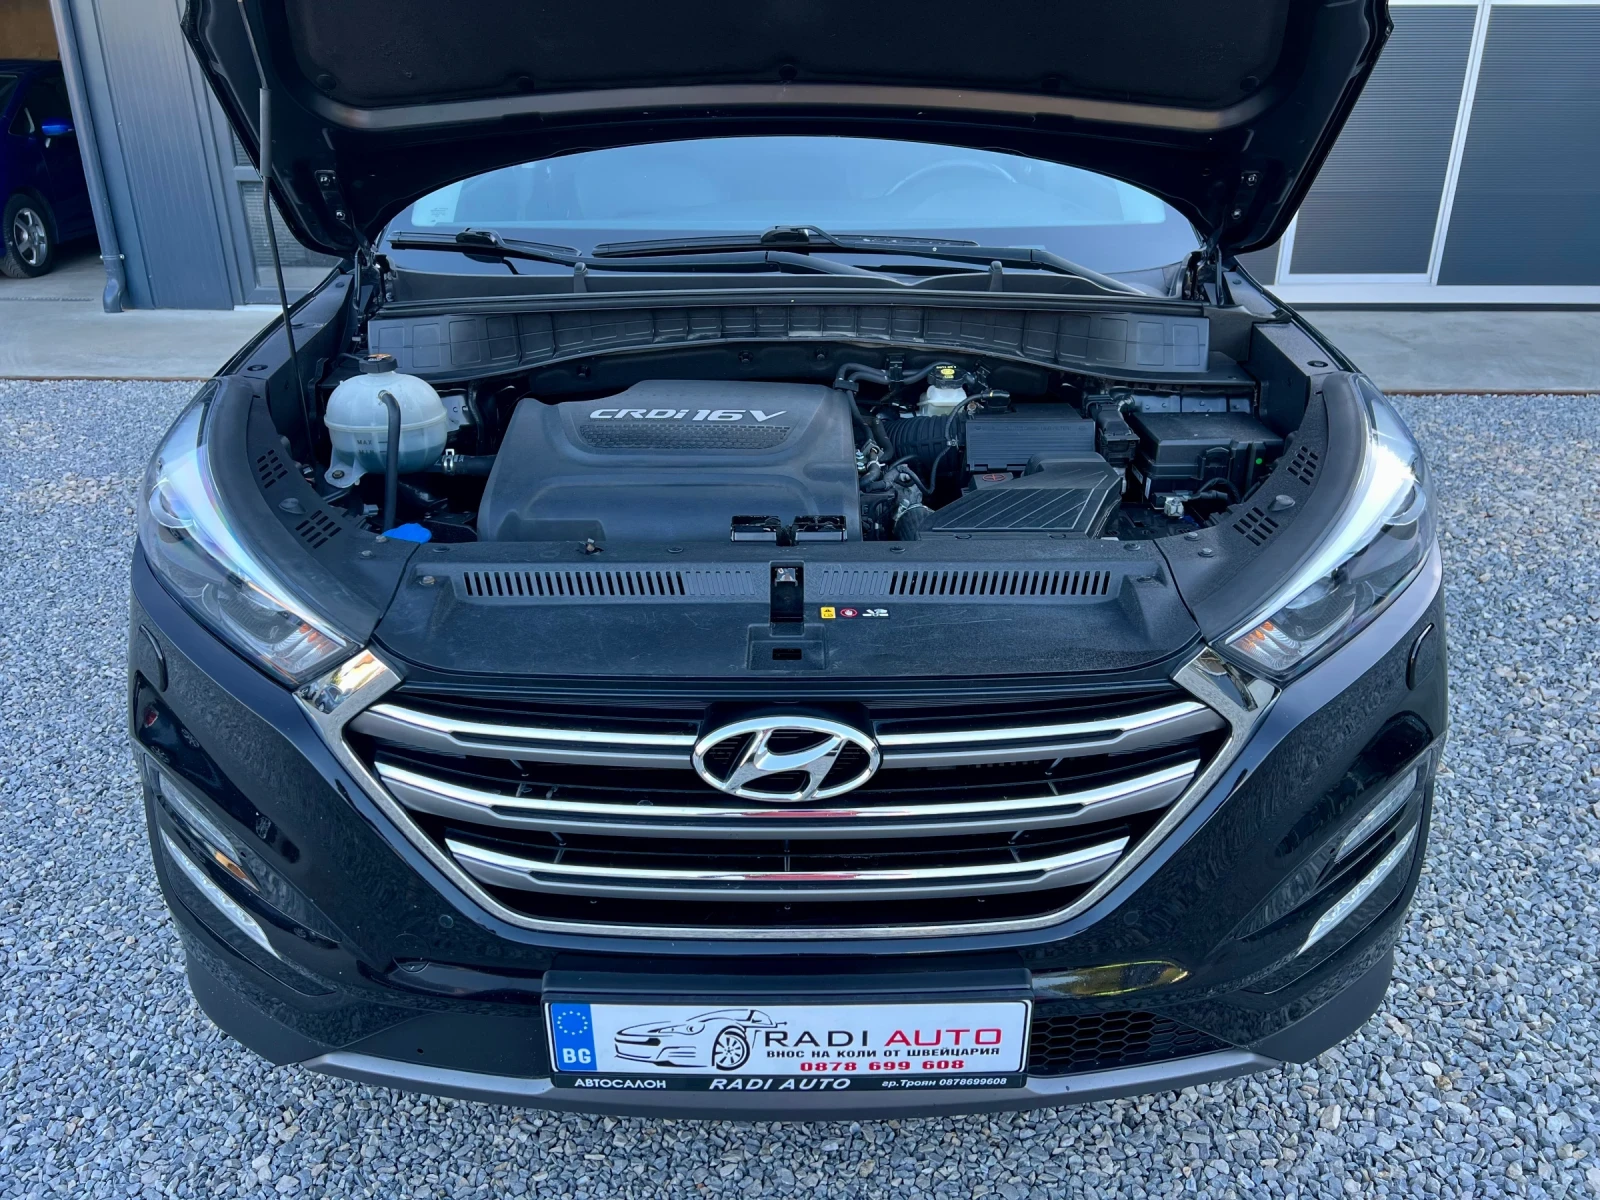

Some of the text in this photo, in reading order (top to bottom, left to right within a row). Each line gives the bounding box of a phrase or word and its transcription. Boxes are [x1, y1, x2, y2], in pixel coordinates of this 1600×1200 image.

[589, 408, 690, 420] CRDi
[764, 1028, 1003, 1048] RADI AUTO
[562, 1048, 592, 1065] BG
[766, 1047, 1001, 1059] ВНОС НА КОЛИ ОТ ШВЕЙЦАРИЯ
[800, 1060, 965, 1072] 0878 699 608
[574, 1078, 667, 1089] АВТОСАЛОН
[708, 1078, 851, 1091] RADI AUTO
[939, 1077, 1008, 1087] 0878699608
